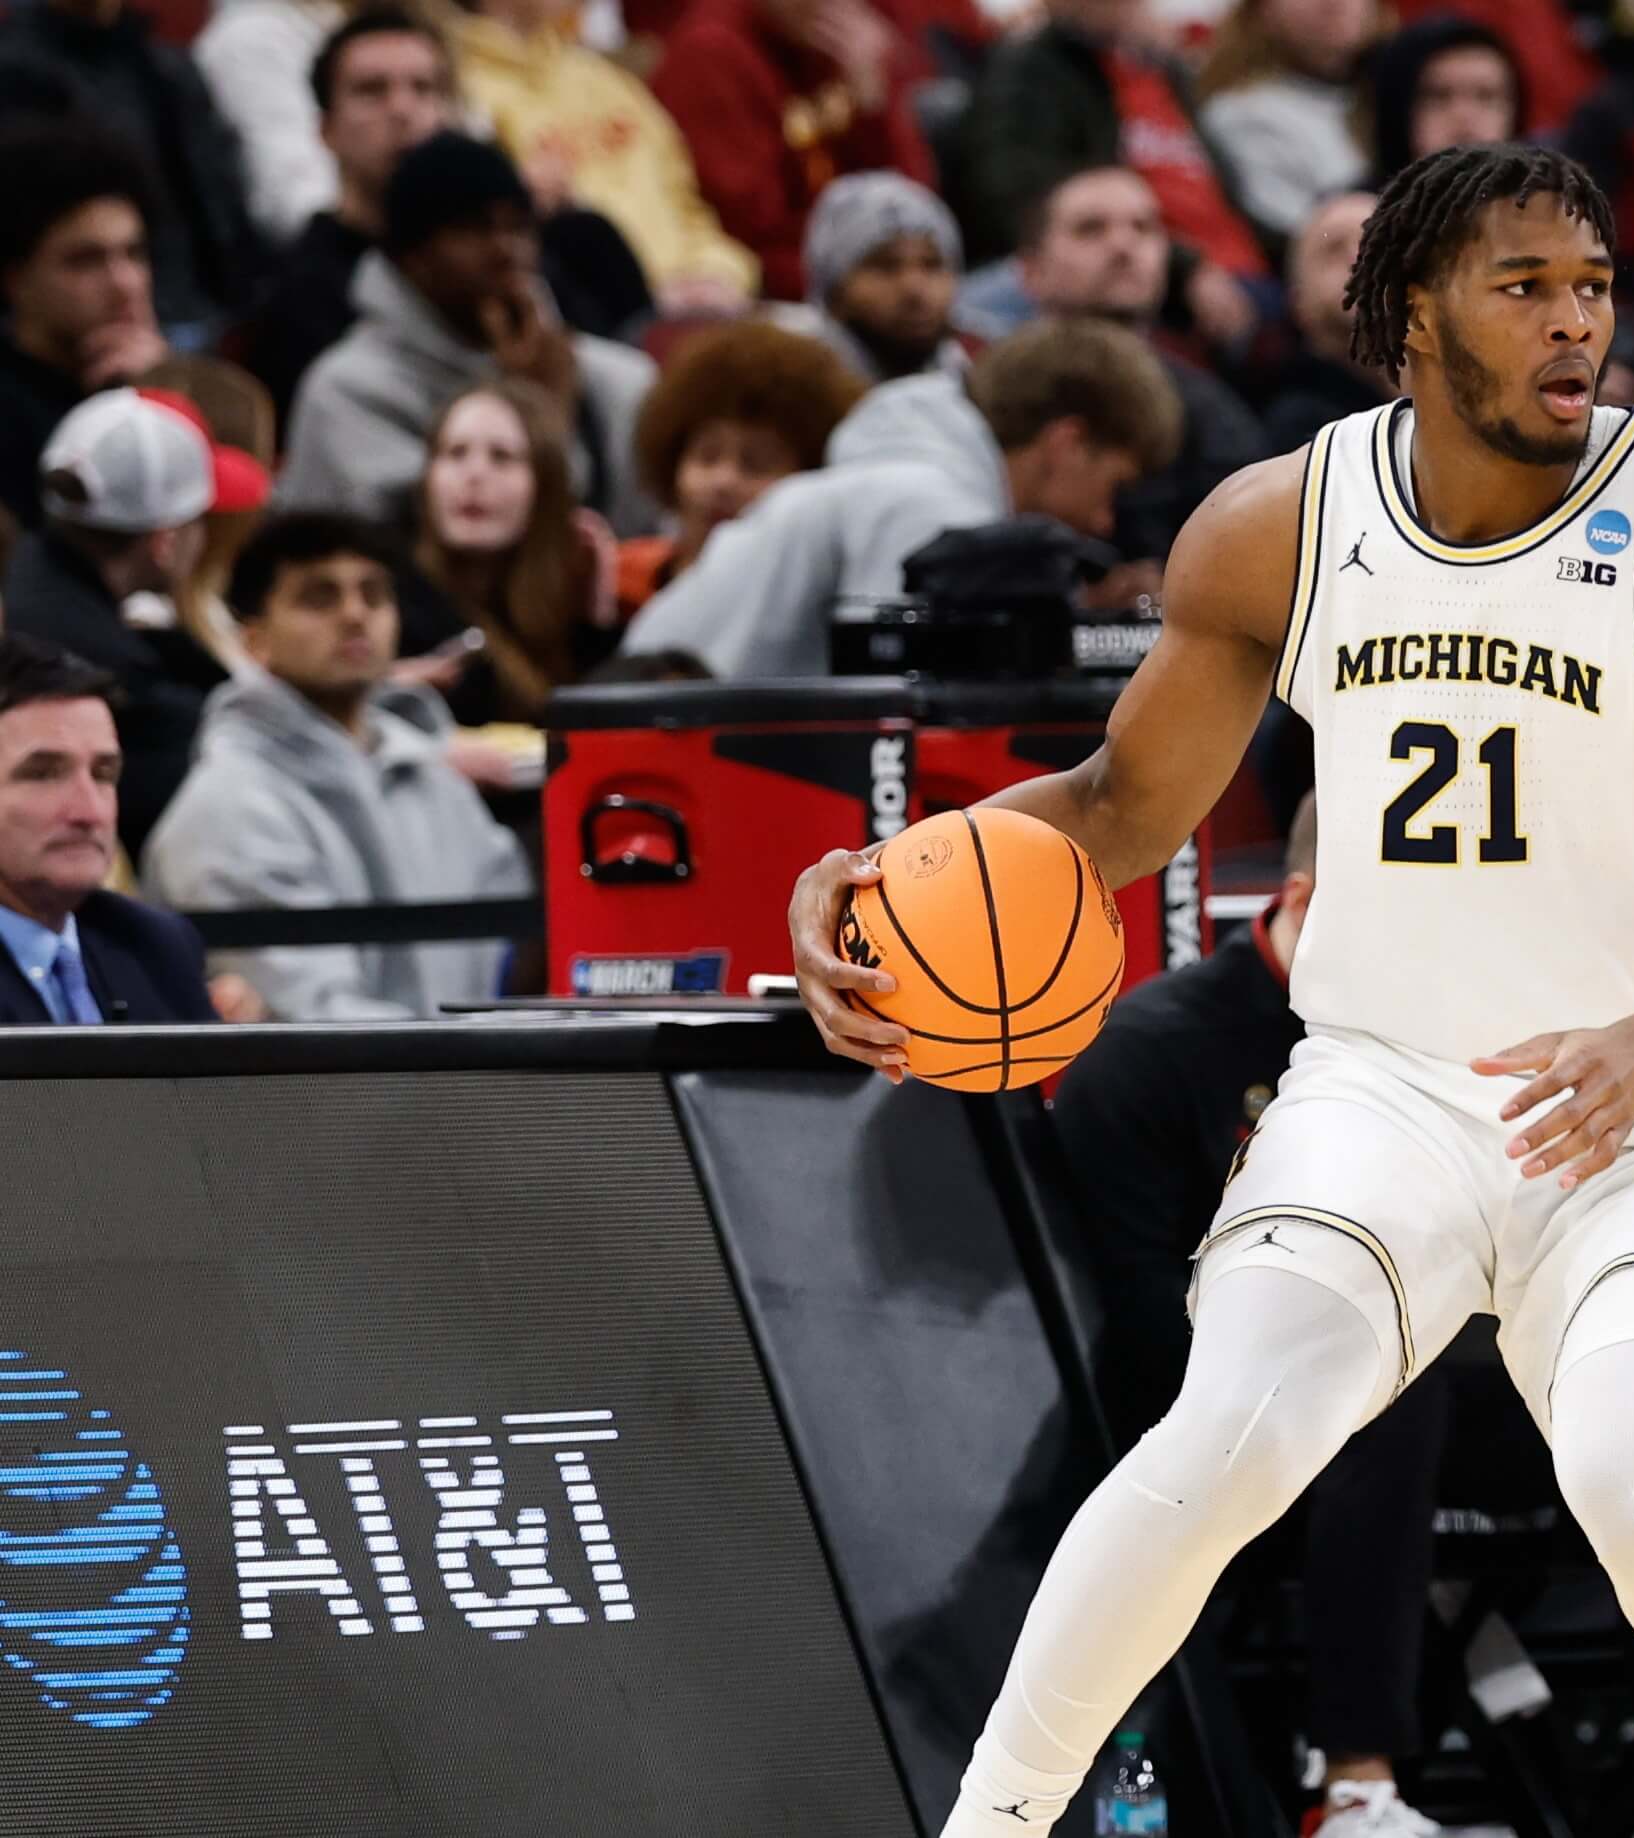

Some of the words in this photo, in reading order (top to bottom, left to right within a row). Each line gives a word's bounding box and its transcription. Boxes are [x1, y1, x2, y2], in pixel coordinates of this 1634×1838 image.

[1590, 527, 1628, 546] NCAA
[1334, 632, 1604, 717] MICHIGAN
[1380, 720, 1531, 868] 21
[222, 1410, 636, 1640] AT&T
